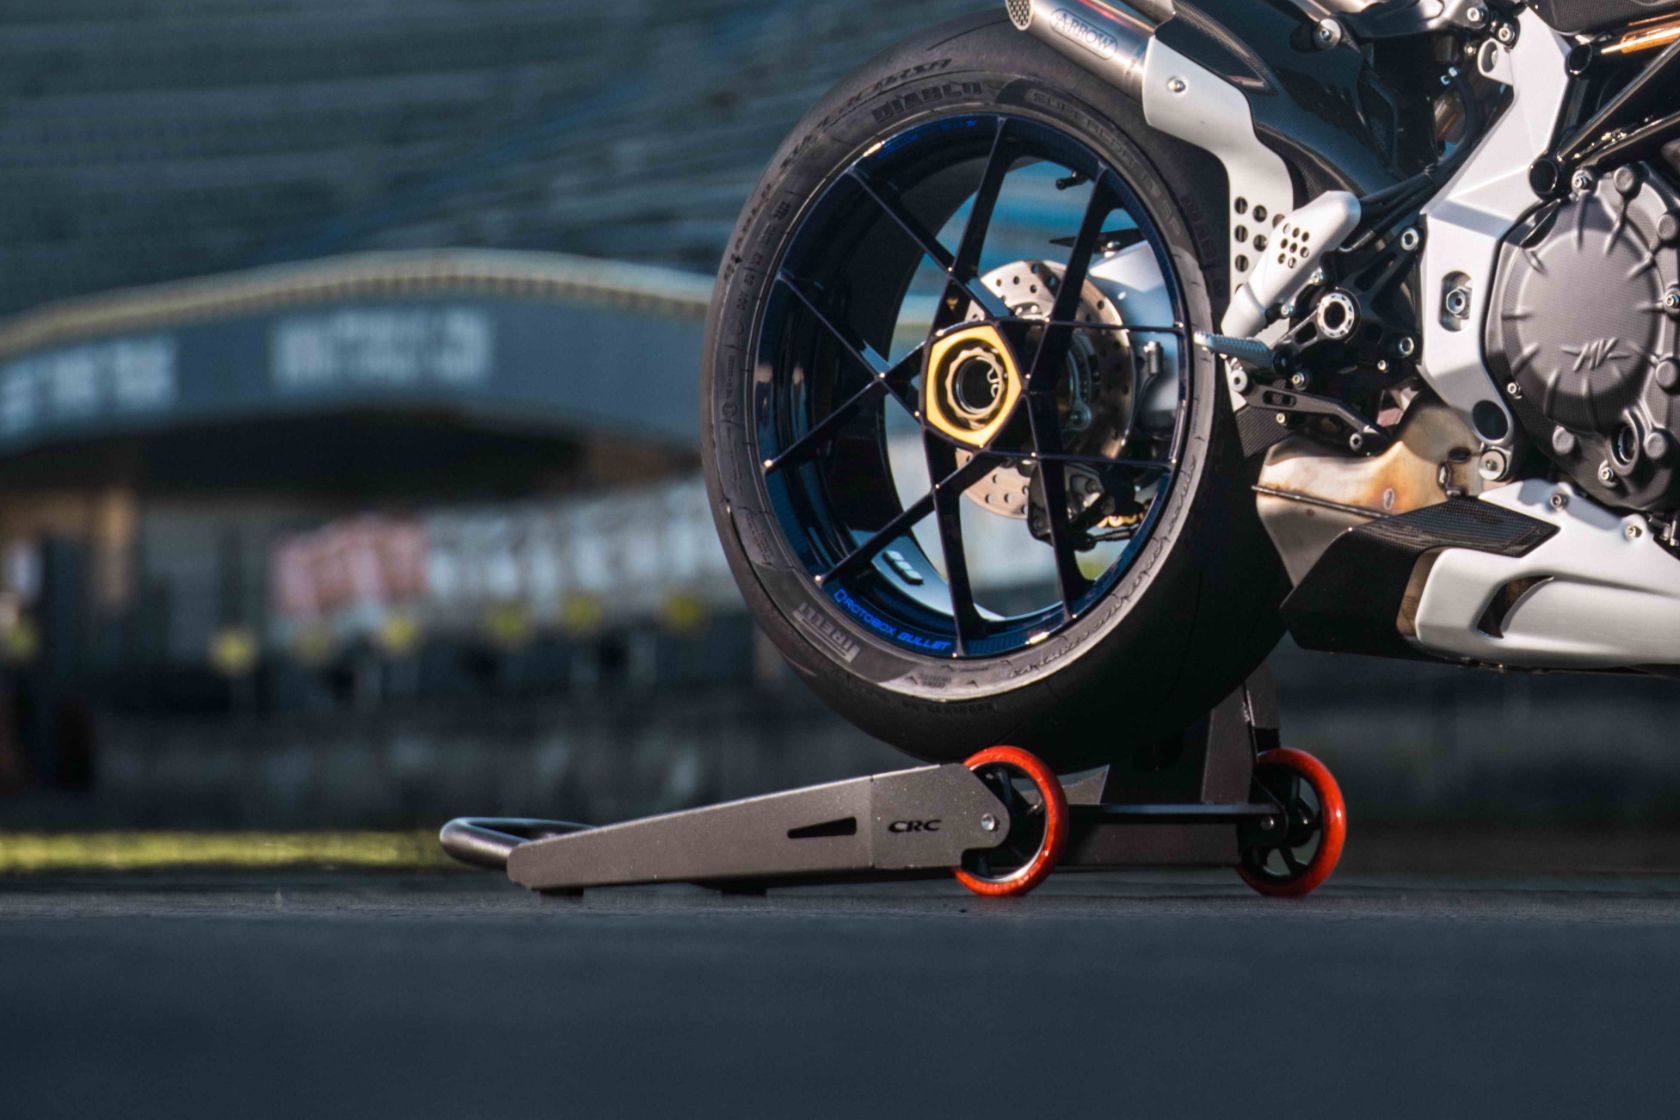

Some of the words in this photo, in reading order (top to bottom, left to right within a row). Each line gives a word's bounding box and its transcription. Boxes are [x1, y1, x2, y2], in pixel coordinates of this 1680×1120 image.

[1054, 12, 1115, 48] ARROW
[871, 82, 982, 124] DIABLO
[793, 602, 861, 663] PIRELLI
[844, 599, 896, 635] ROTOBOX
[897, 631, 952, 651] BULLET
[888, 819, 942, 833] CRC
